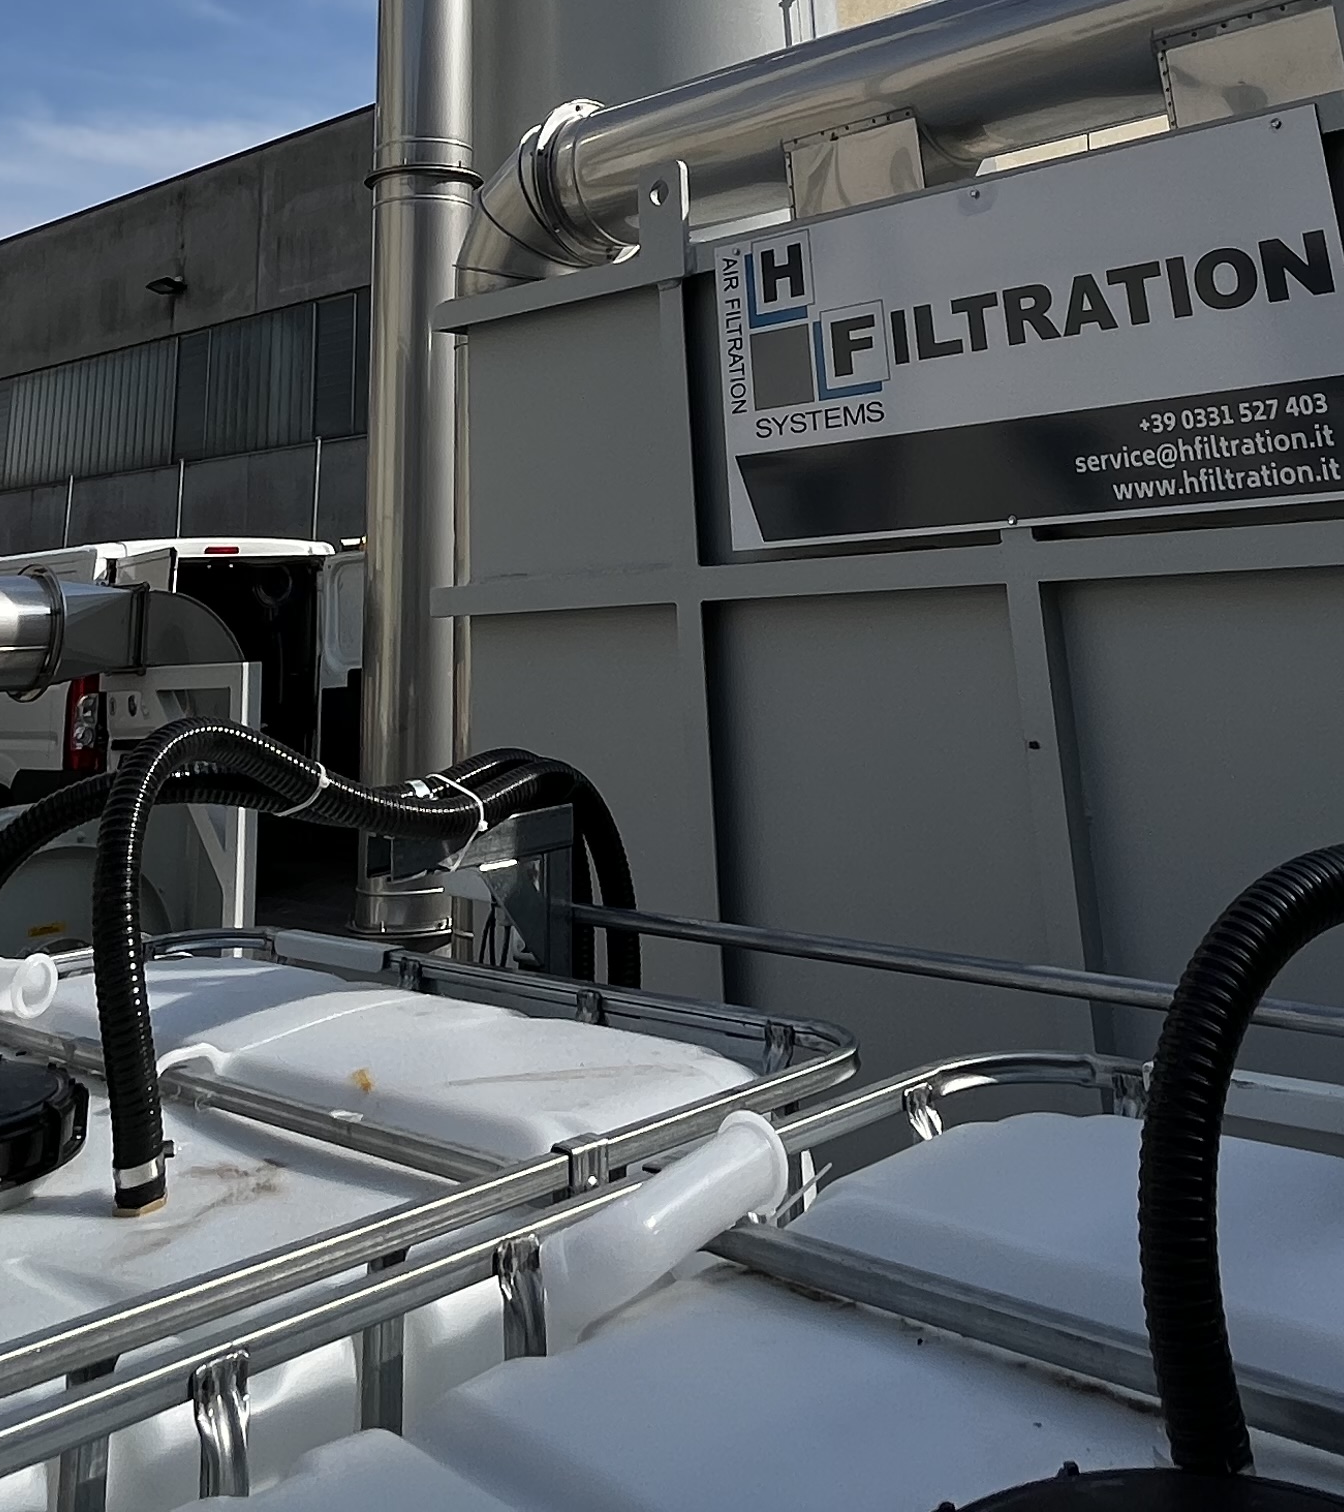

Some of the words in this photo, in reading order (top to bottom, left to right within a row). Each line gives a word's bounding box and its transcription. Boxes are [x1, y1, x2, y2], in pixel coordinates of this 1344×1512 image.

[722, 257, 739, 292] AIR
[760, 243, 805, 304] H
[830, 229, 1335, 378] FILTRATION
[724, 298, 747, 415] FILTRATION
[755, 401, 885, 439] SYSTEMS
[1139, 412, 1176, 434] +39
[1181, 405, 1234, 430] 0331
[1239, 399, 1278, 422] 527
[1285, 393, 1328, 417] 403
[1075, 424, 1335, 473] service@hfiltration.it
[1112, 457, 1341, 501] www.hfiltration.it
